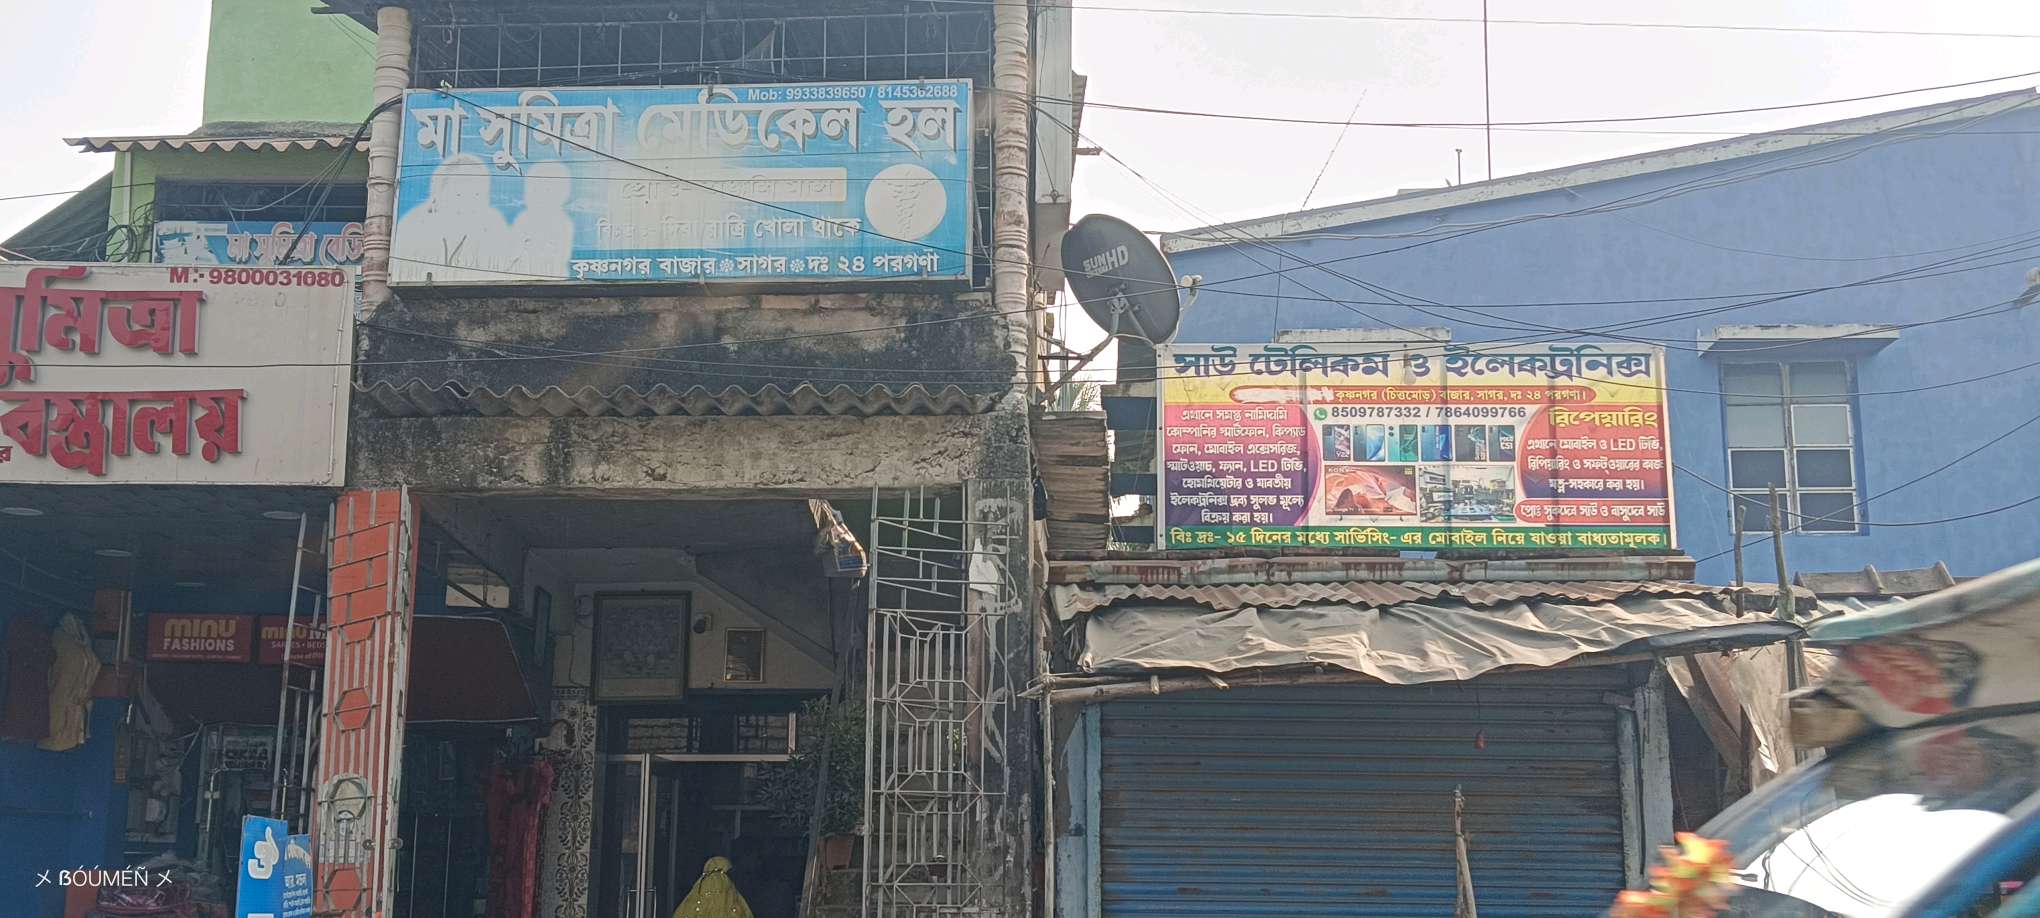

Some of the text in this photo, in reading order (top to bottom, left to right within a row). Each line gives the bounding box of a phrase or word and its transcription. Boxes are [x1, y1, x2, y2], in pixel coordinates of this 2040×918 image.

[748, 88, 782, 101] Mob:
[786, 87, 866, 101] 9933839650
[877, 85, 958, 99] 8145362688
[411, 88, 961, 177] মা সুমিত্রা মেডিকেল হল
[810, 217, 863, 241] থাকে
[571, 256, 652, 281] কৃষ্ণনগর
[656, 256, 717, 279] বাজার
[736, 255, 788, 275] সাগর
[837, 256, 866, 274] ২৪
[208, 268, 345, 288] 9800031080
[1173, 345, 1238, 378] সাউ
[1248, 344, 1390, 378] টেলিকম
[1444, 345, 1652, 382] ইলেকট্রনিক্স
[1331, 406, 1422, 419] 8509787332
[1435, 405, 1527, 419] 7864099766
[1549, 405, 1658, 428] রিপেয়ারিং
[1609, 438, 1636, 451] LED
[1250, 459, 1278, 472] LED
[1251, 528, 1292, 545] দিনের
[1429, 528, 1487, 545] মোবাইল
[162, 637, 236, 652] FASHIONS
